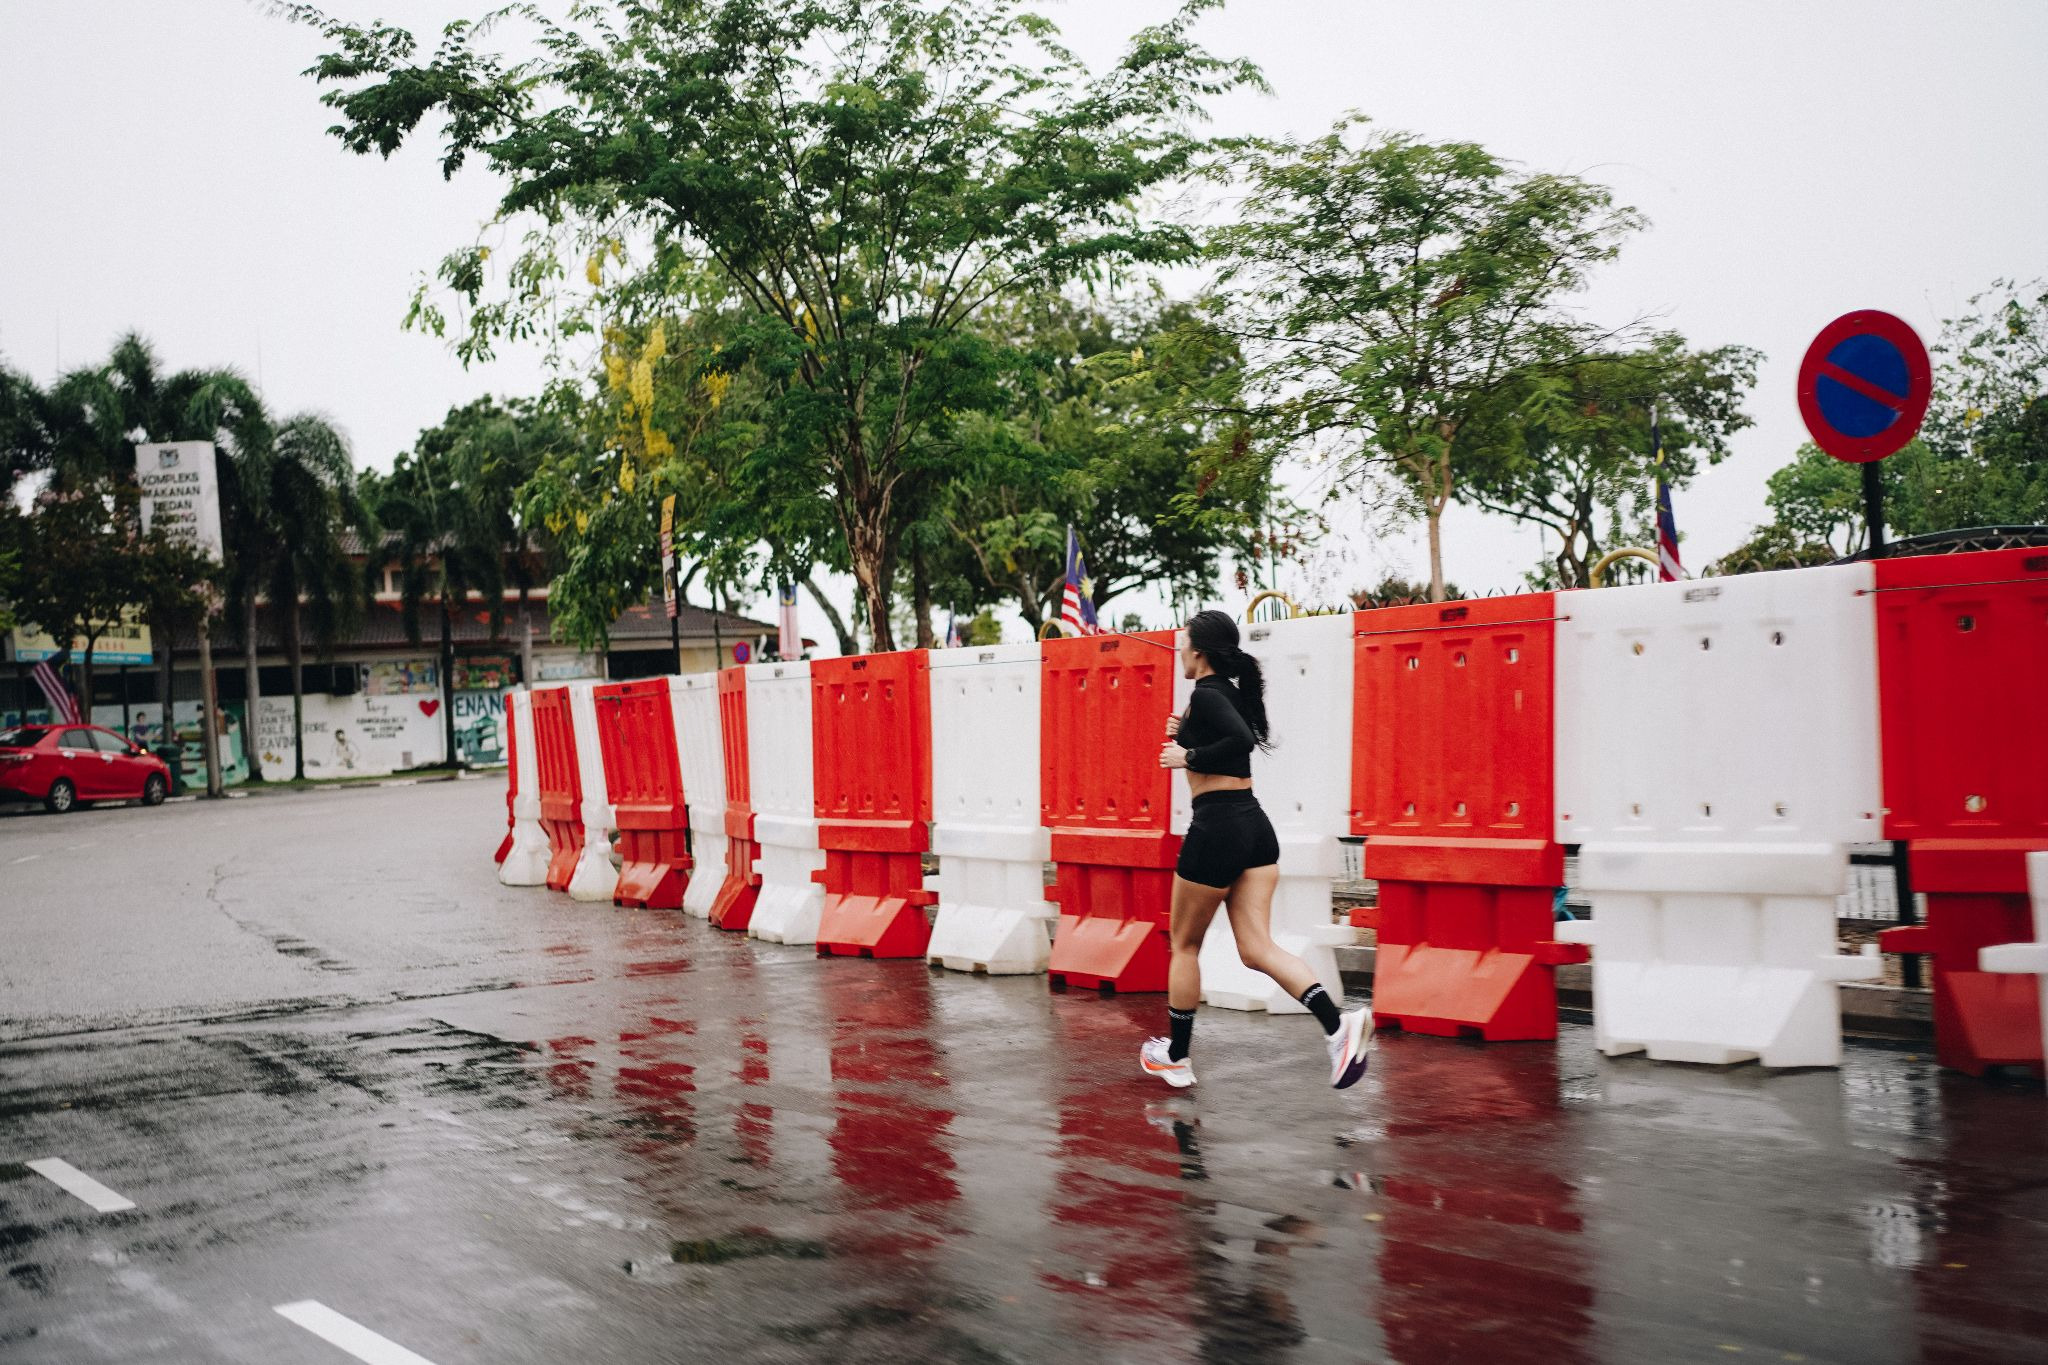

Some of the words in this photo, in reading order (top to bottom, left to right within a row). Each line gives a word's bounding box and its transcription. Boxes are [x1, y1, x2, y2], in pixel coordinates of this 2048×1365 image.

[142, 472, 199, 485] KOMPLEKS
[143, 485, 201, 497] MAKANAN
[455, 691, 507, 717] ENAN
